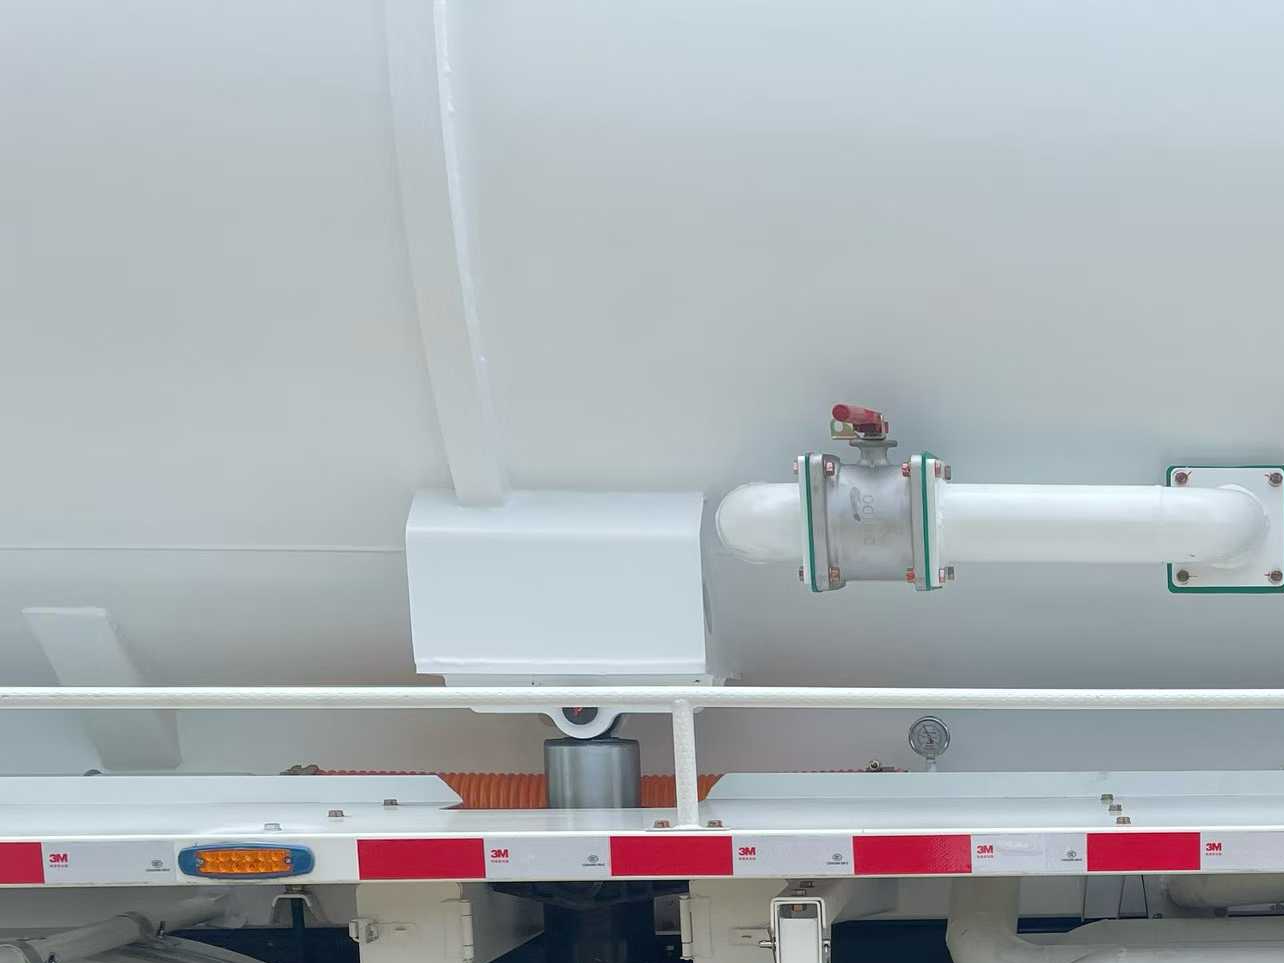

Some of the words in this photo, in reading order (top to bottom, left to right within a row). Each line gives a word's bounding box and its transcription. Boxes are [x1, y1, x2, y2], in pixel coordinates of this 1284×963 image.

[739, 847, 756, 856] 3M
[977, 845, 993, 854] 3M
[1206, 843, 1222, 851] 3M
[49, 853, 68, 863] 3M
[491, 849, 509, 858] 3M
